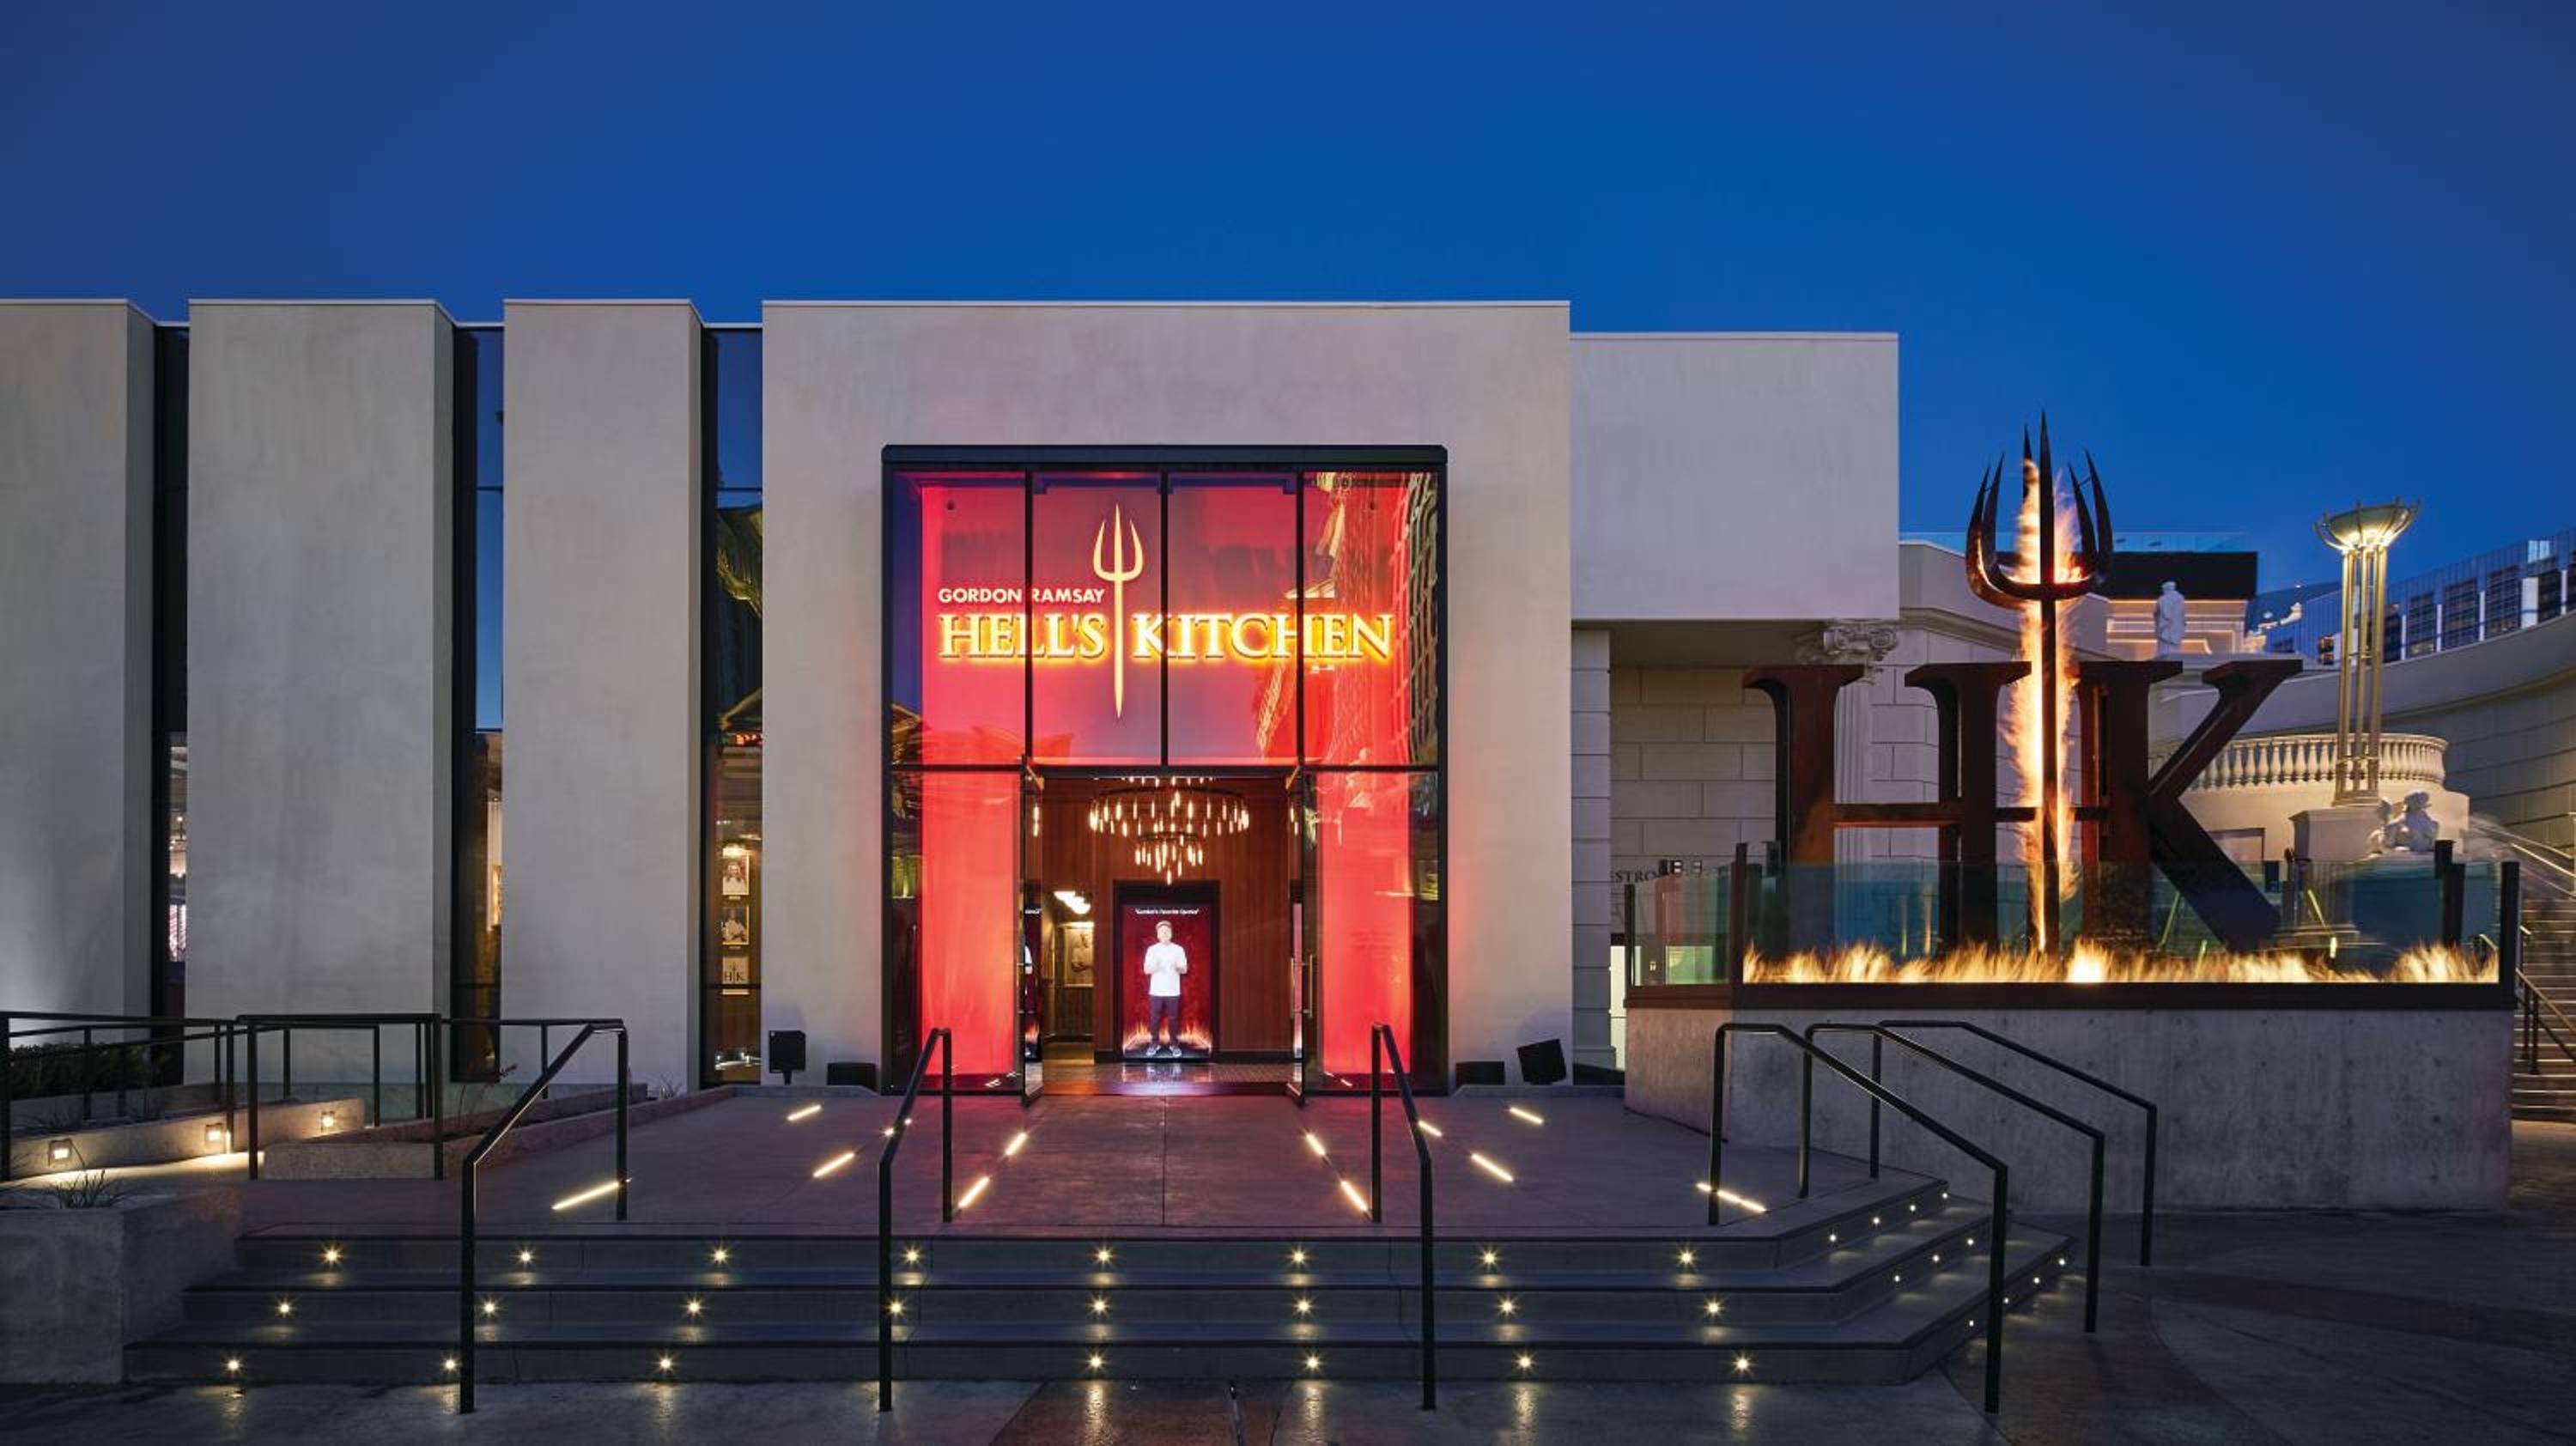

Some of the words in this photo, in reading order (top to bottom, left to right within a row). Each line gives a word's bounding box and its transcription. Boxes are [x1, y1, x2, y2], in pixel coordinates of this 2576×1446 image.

[938, 587, 1022, 604] GORDON
[1031, 588, 1105, 604] RAMSAY
[939, 612, 1106, 658] HELL'S
[1132, 612, 1394, 659] KITCHEN
